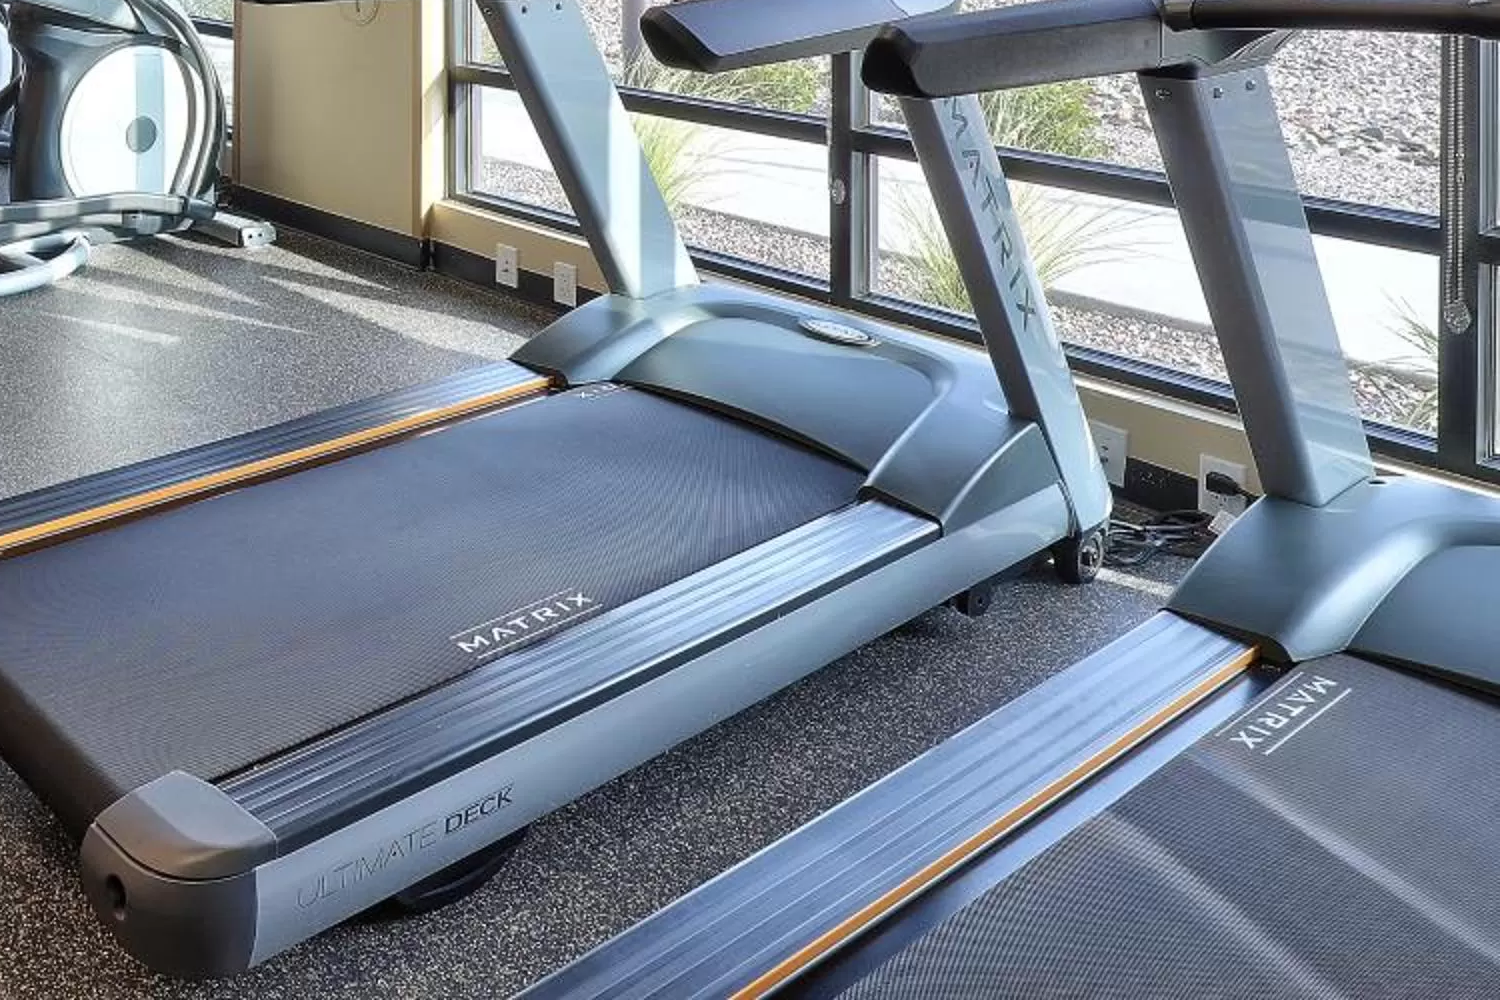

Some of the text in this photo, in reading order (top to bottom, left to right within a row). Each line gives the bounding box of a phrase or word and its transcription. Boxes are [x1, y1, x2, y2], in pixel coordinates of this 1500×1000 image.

[457, 591, 592, 653] MATRIX
[1232, 675, 1338, 750] MATRIX
[296, 786, 513, 909] ULTIMATE DECK
